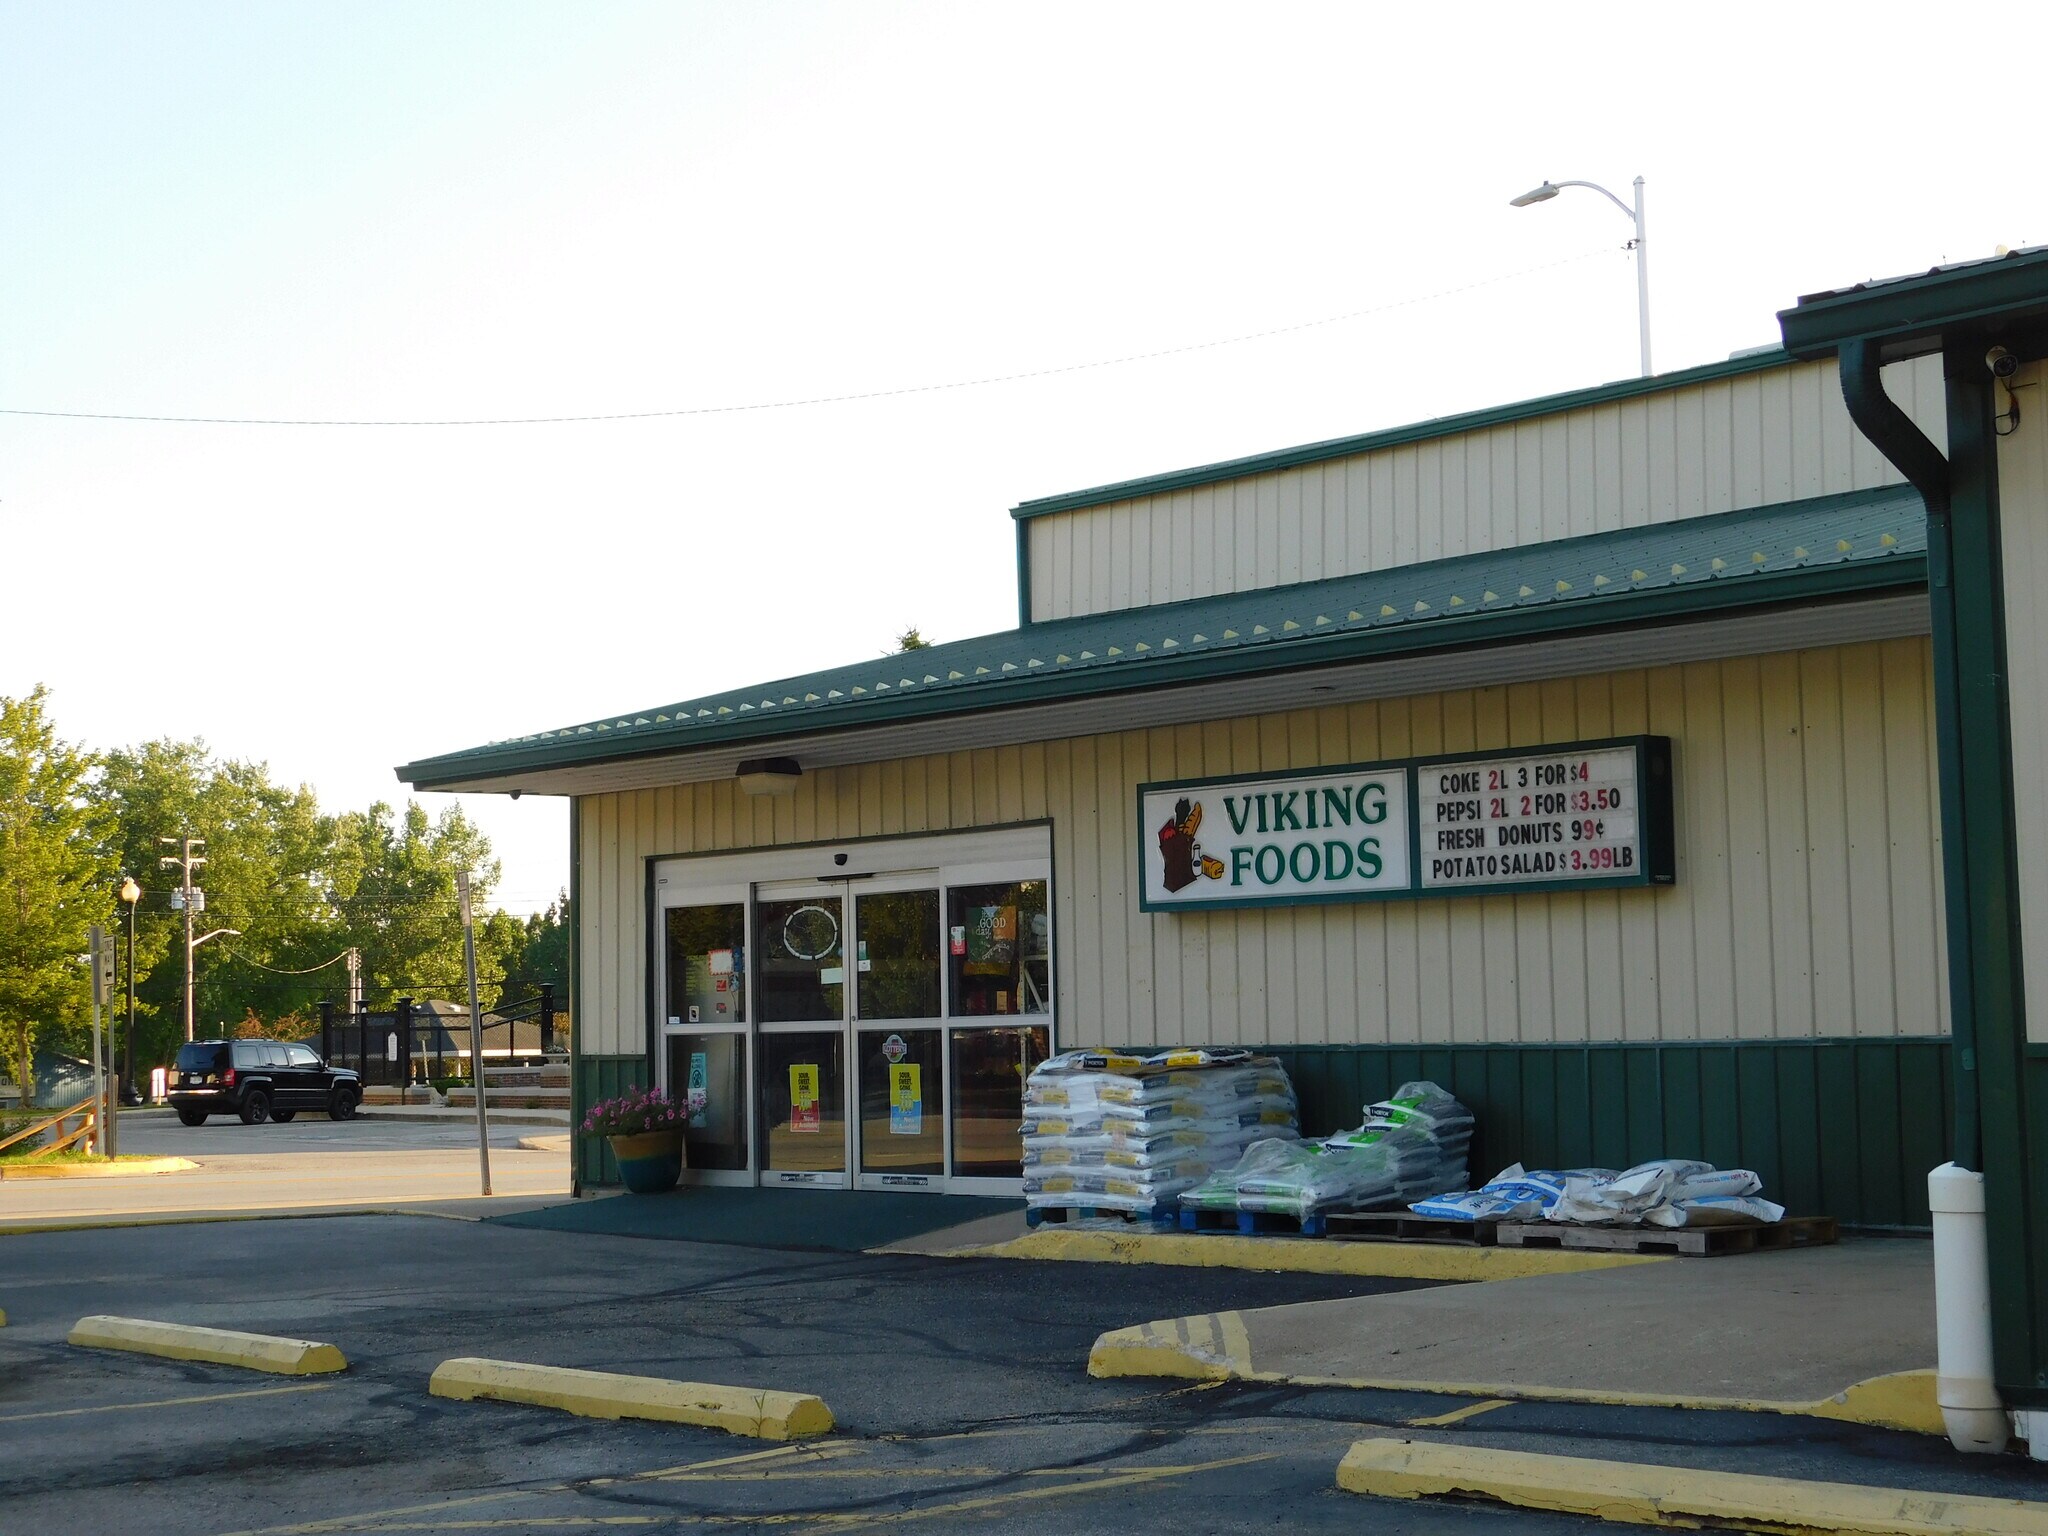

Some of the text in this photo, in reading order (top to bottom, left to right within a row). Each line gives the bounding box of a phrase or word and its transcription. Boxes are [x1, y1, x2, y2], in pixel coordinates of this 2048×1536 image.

[1440, 762, 1588, 794] COKE 2L 3 FOR $4
[1223, 781, 1388, 836] VIKING
[1437, 787, 1621, 822] PEPSI 2L 2 FOR $3.50
[1438, 818, 1605, 850] FRESH DONUTS 99¢
[1230, 837, 1383, 886] FOODS
[1433, 855, 1498, 879] POTATO
[1501, 852, 1555, 876] SALAD
[980, 917, 1006, 928] GOOD
[883, 1045, 906, 1053] LOTTERY
